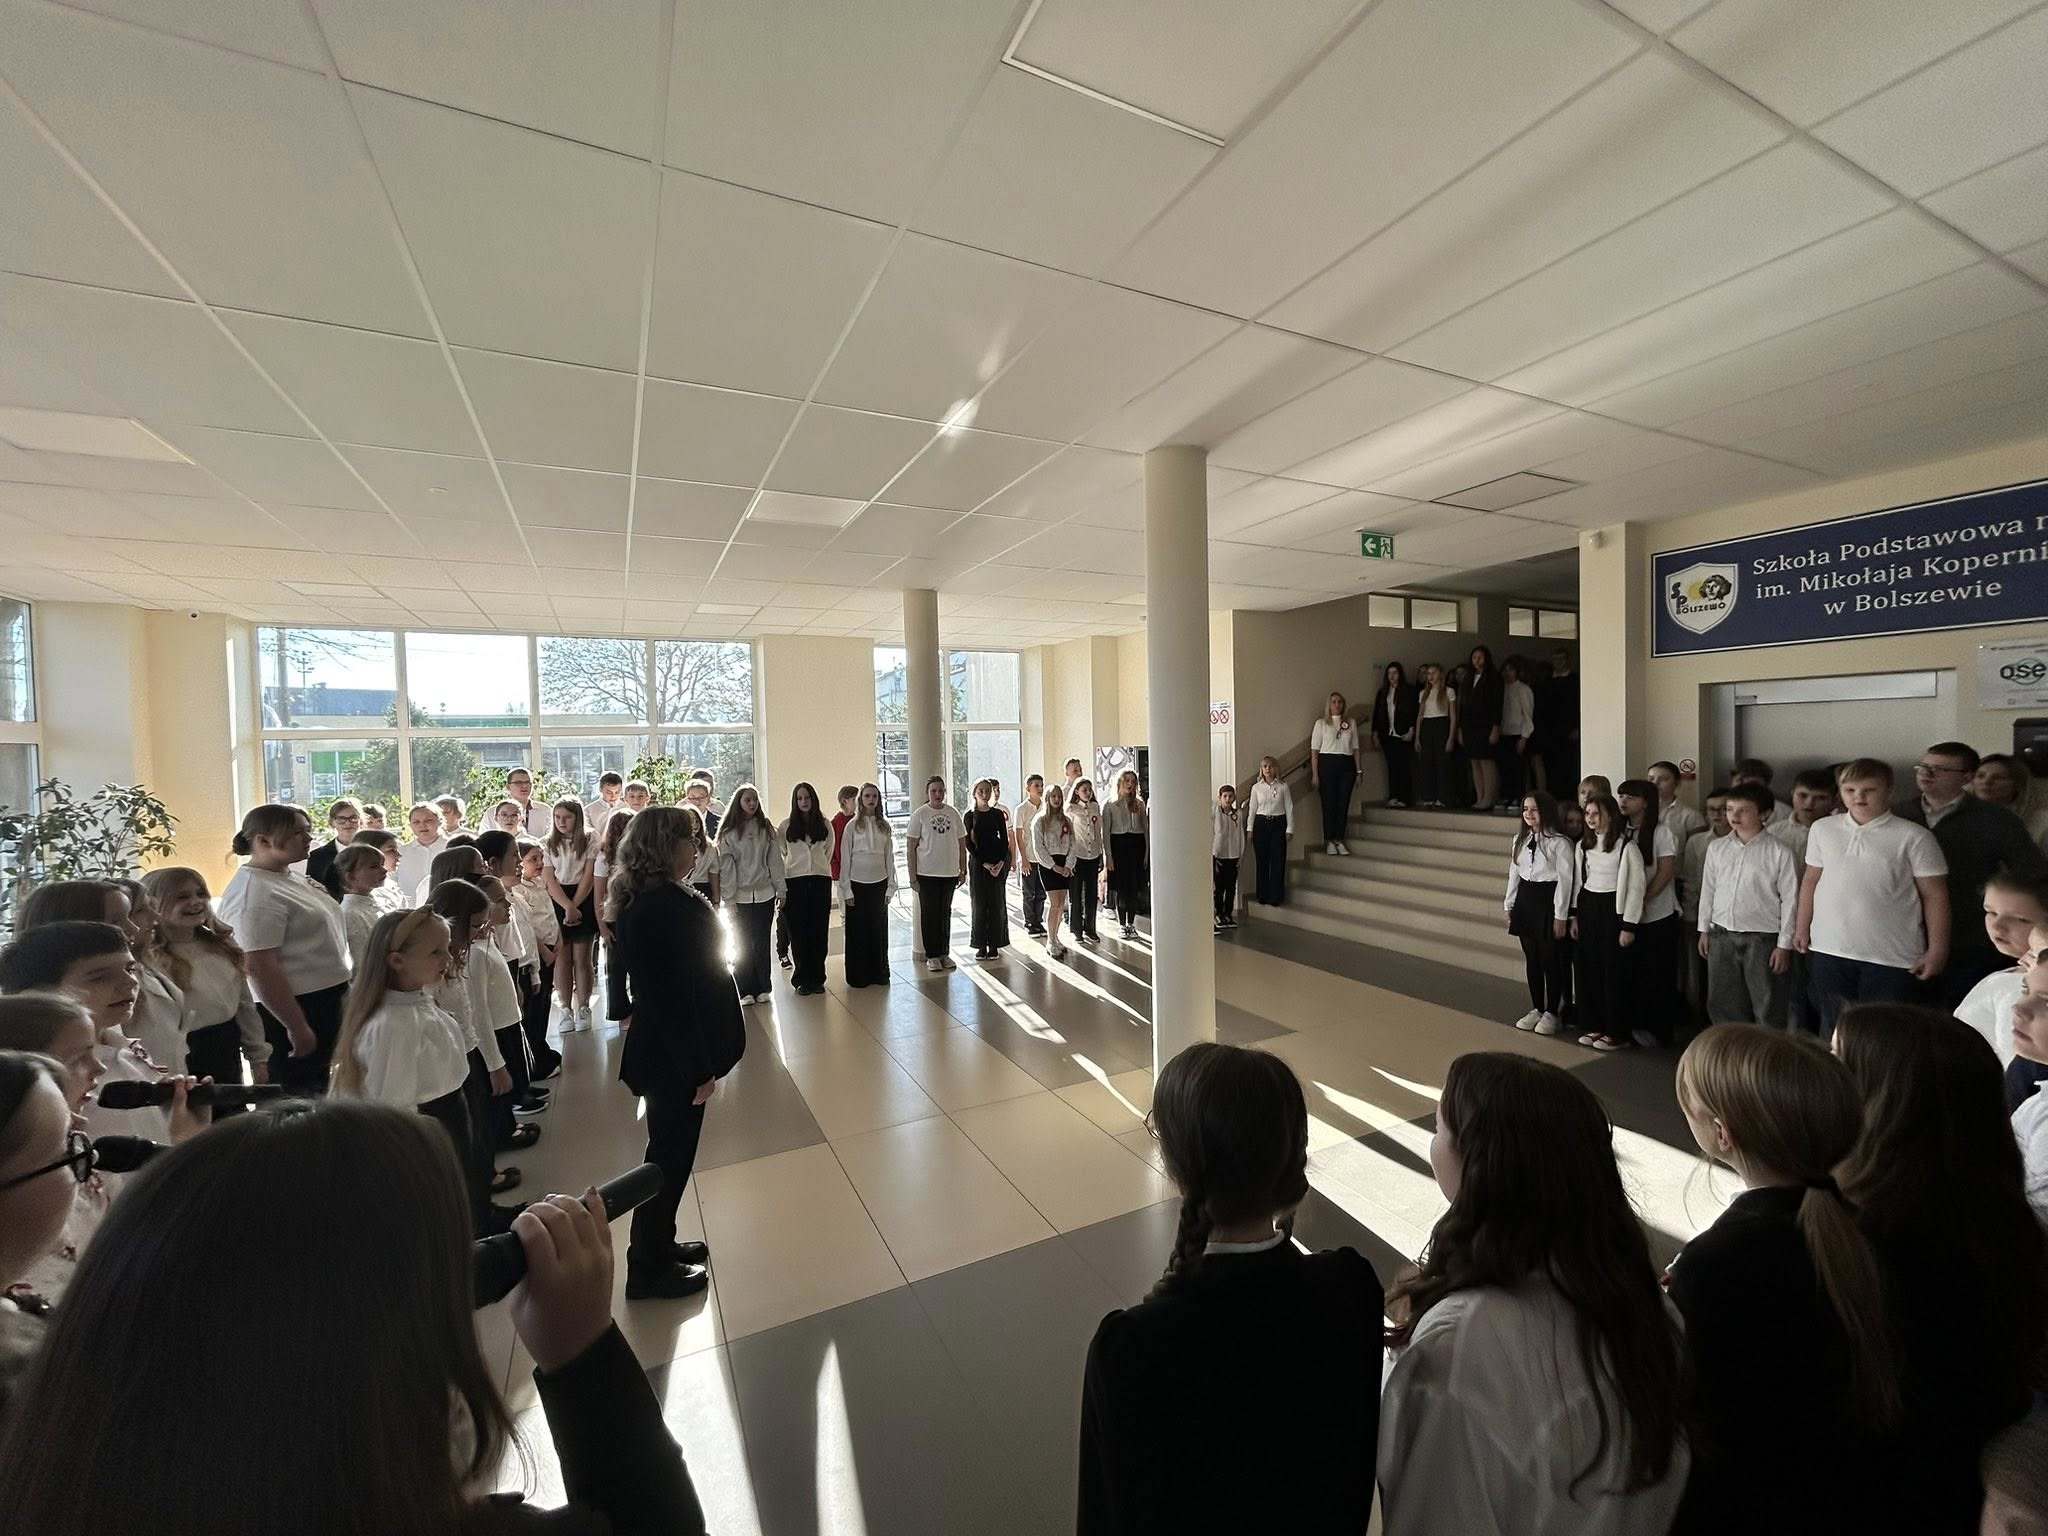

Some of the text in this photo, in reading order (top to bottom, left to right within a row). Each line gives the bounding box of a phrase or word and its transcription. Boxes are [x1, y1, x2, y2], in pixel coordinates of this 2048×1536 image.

[1753, 549, 1831, 575] Szkoła
[1840, 519, 2024, 562] Podstawowa
[1756, 583, 1791, 599] im.
[1800, 563, 1913, 594] Mikołaja
[1824, 580, 2002, 615] w Bolszewie
